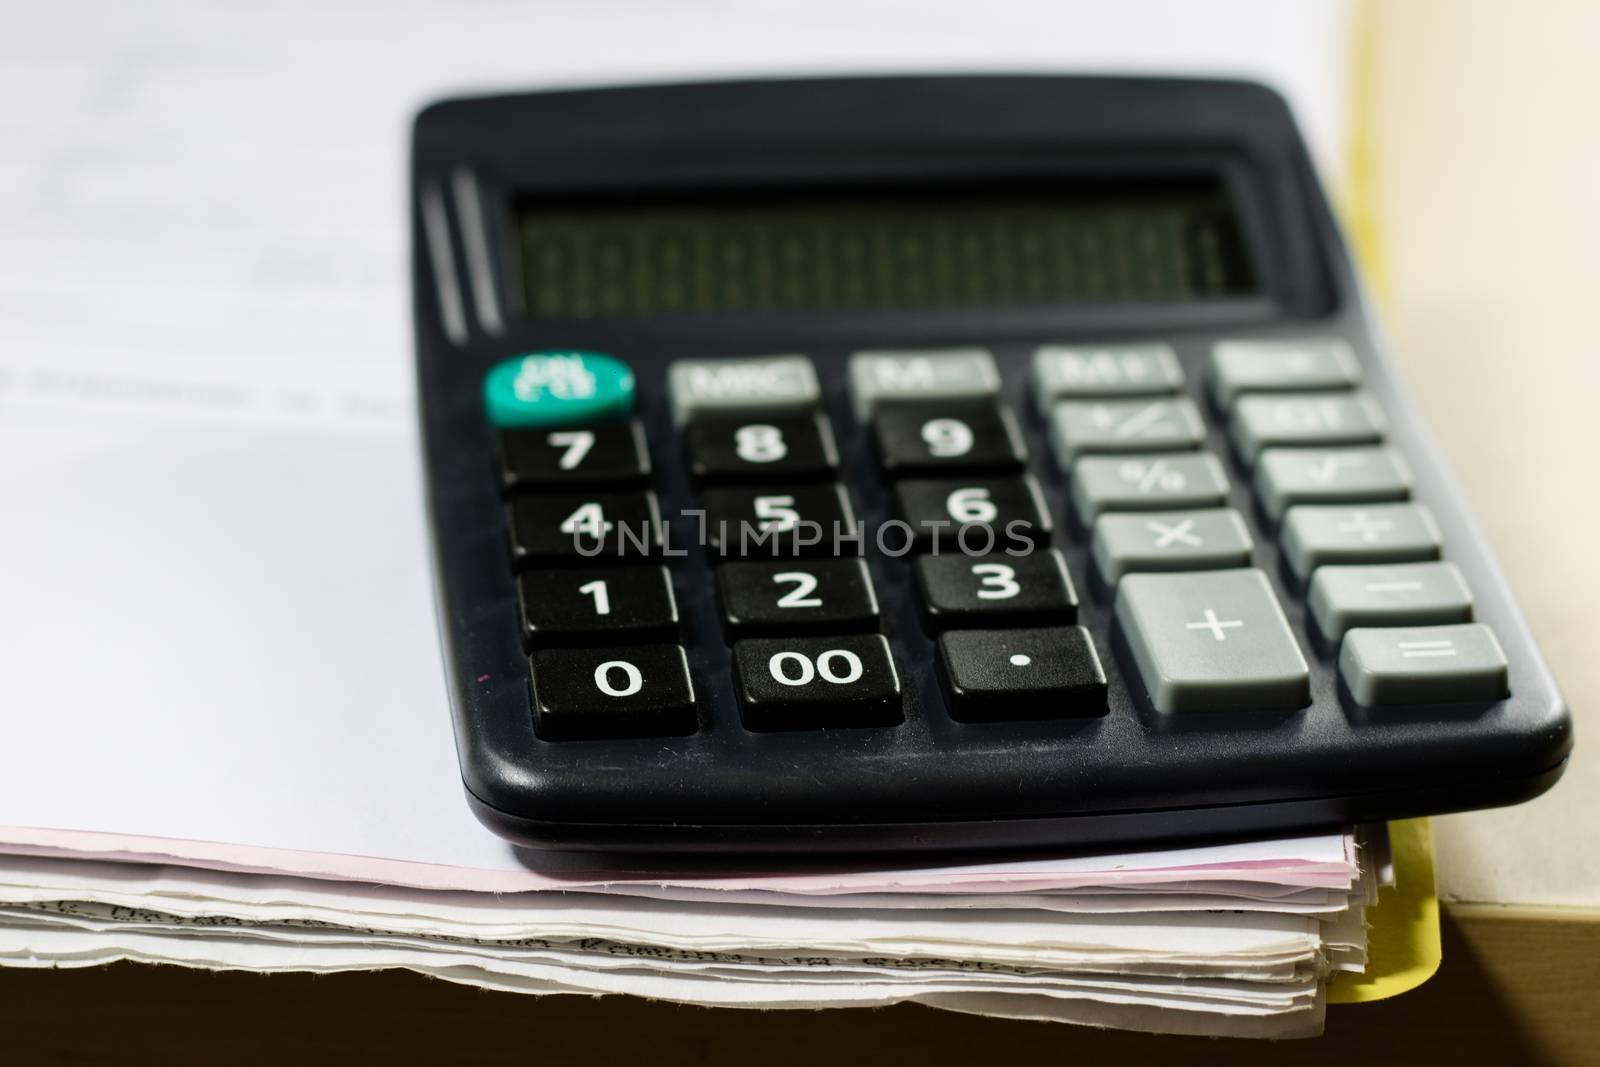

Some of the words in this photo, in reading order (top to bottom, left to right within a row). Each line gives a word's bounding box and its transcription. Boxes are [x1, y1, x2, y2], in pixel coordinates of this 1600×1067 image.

[547, 431, 595, 470] 7
[734, 424, 788, 463] 8
[921, 418, 975, 458] 9
[559, 503, 613, 538] 4
[753, 496, 801, 533] 5
[946, 487, 998, 525] 6
[578, 580, 611, 616] 1
[772, 572, 824, 609] 2
[970, 563, 1022, 600] 3
[593, 660, 644, 698] 0
[768, 649, 864, 687] 00
